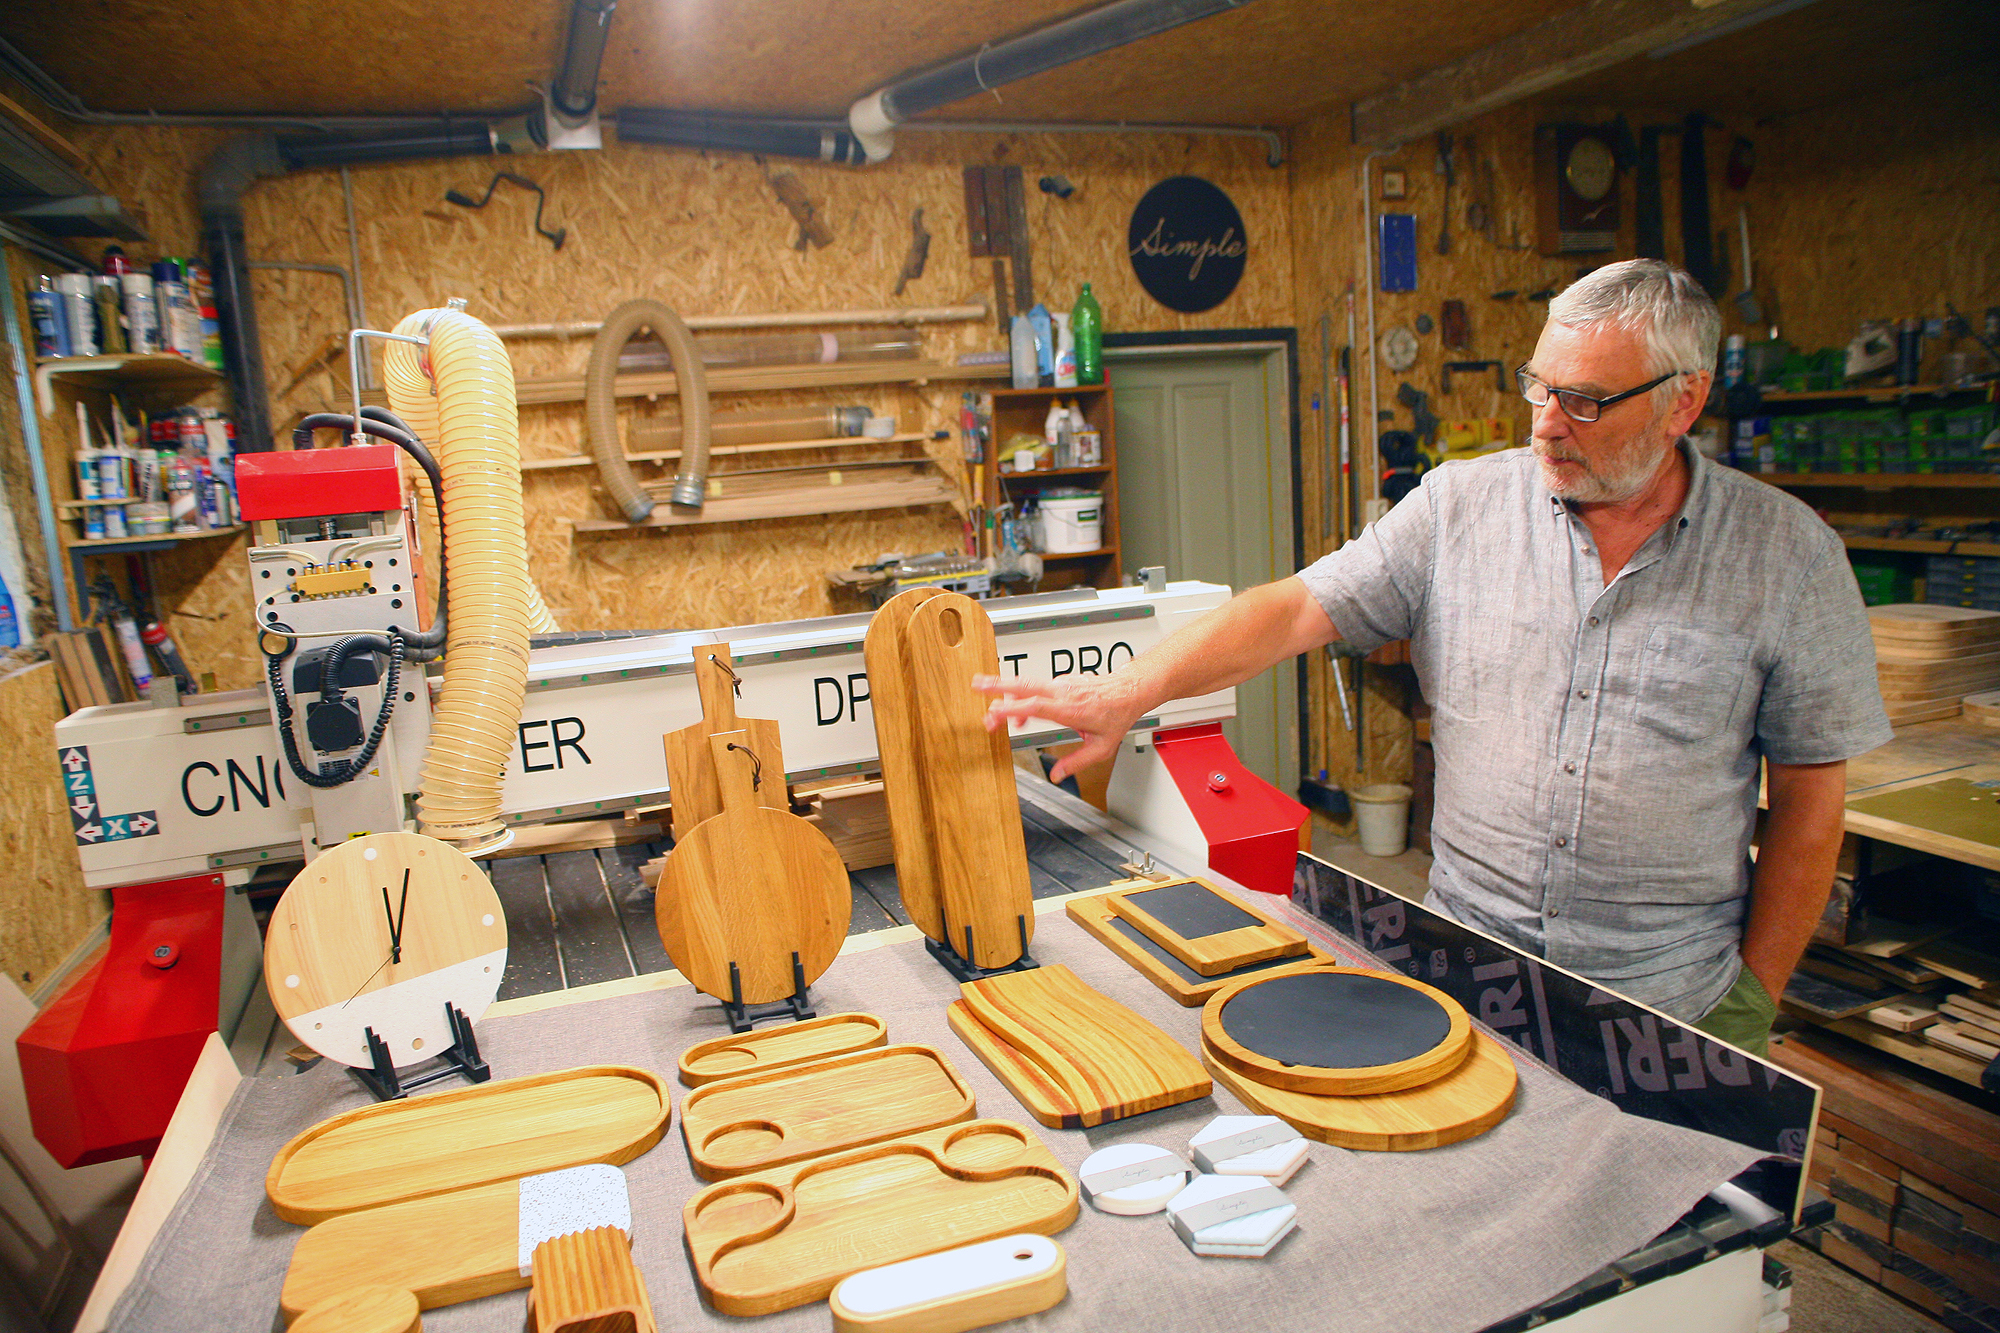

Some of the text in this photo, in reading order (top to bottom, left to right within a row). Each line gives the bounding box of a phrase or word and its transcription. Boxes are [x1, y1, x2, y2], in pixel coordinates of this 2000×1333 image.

[1130, 217, 1247, 281] Simple
[69, 773, 89, 791] Z
[181, 755, 287, 818] CN
[518, 716, 592, 773] ER
[105, 818, 128, 836] X
[1600, 1014, 1752, 1094] PERI
